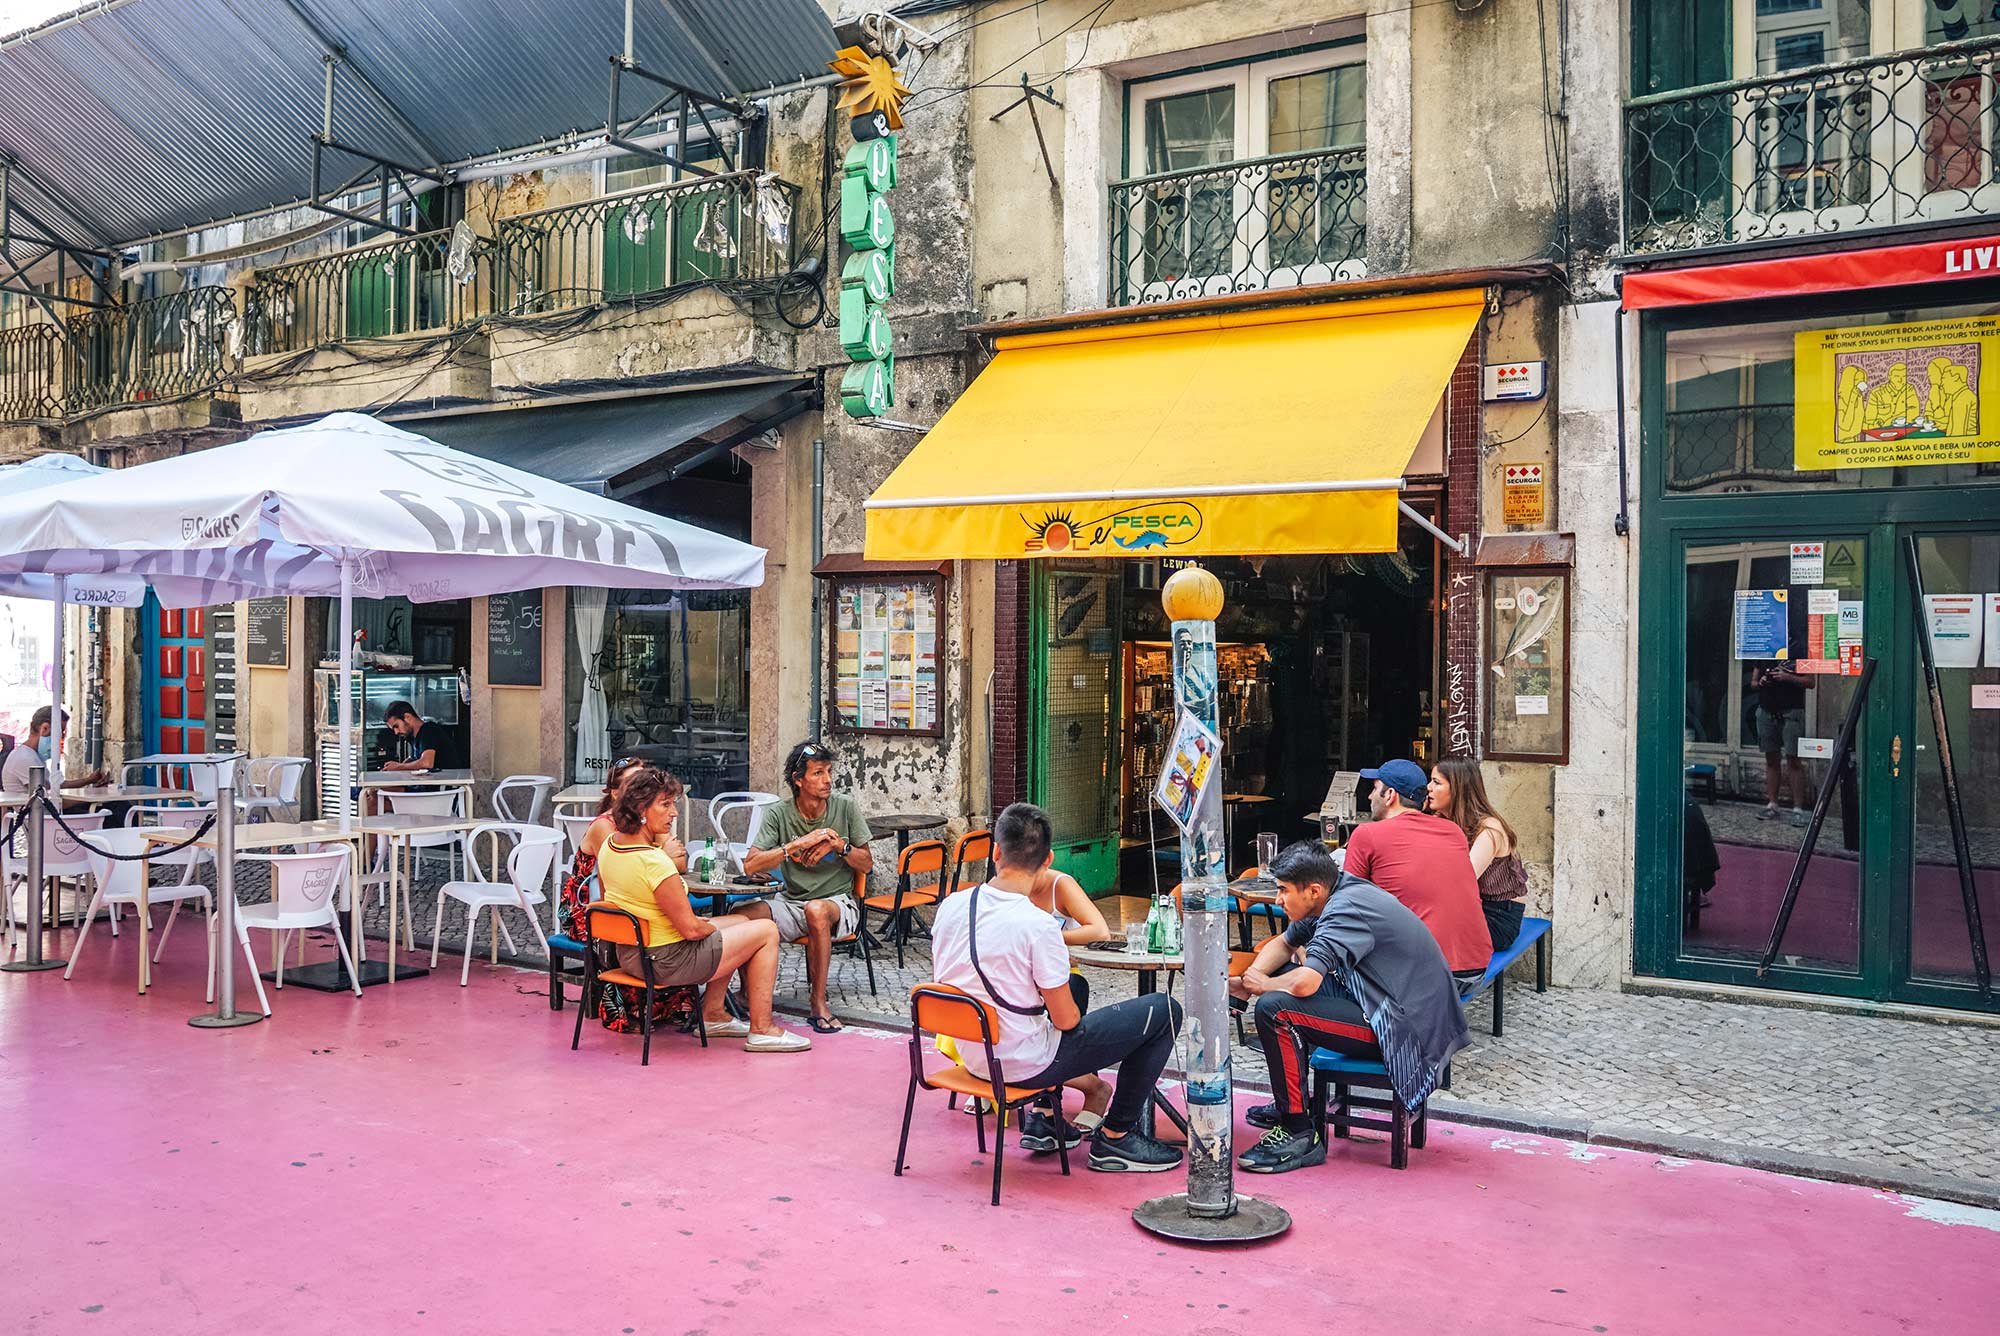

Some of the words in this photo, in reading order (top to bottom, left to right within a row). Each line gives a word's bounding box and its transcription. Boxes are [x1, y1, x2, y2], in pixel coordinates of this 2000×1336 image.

[1946, 245, 2000, 273] LIV
[869, 139, 888, 411] PESCA
[1821, 342, 1834, 350] THE
[1858, 339, 1879, 347] STAYS
[1880, 337, 1895, 345] BUT
[1912, 334, 1935, 342] BOOK
[1942, 331, 1968, 339] YOURS
[1825, 333, 1839, 341] BUY
[1840, 332, 1861, 340] YOUR
[1862, 328, 1901, 338] FAVOURITE
[1902, 326, 1924, 334] BOOK
[1925, 325, 1942, 333] AND
[1943, 323, 1964, 331] HAVE
[1972, 320, 1996, 328] DRINK
[1818, 448, 1850, 456] COMPRE
[1859, 446, 1881, 454] LIVRO
[1882, 445, 1894, 453] DA
[1939, 442, 1960, 450] BEBA
[1961, 441, 1975, 449] UM
[1977, 440, 2000, 448] COPO
[1923, 452, 1947, 460] LIVRO
[1090, 526, 1111, 545] e
[1113, 515, 1193, 528] PESCA
[520, 606, 542, 629] 5€
[1843, 611, 1858, 619] MB
